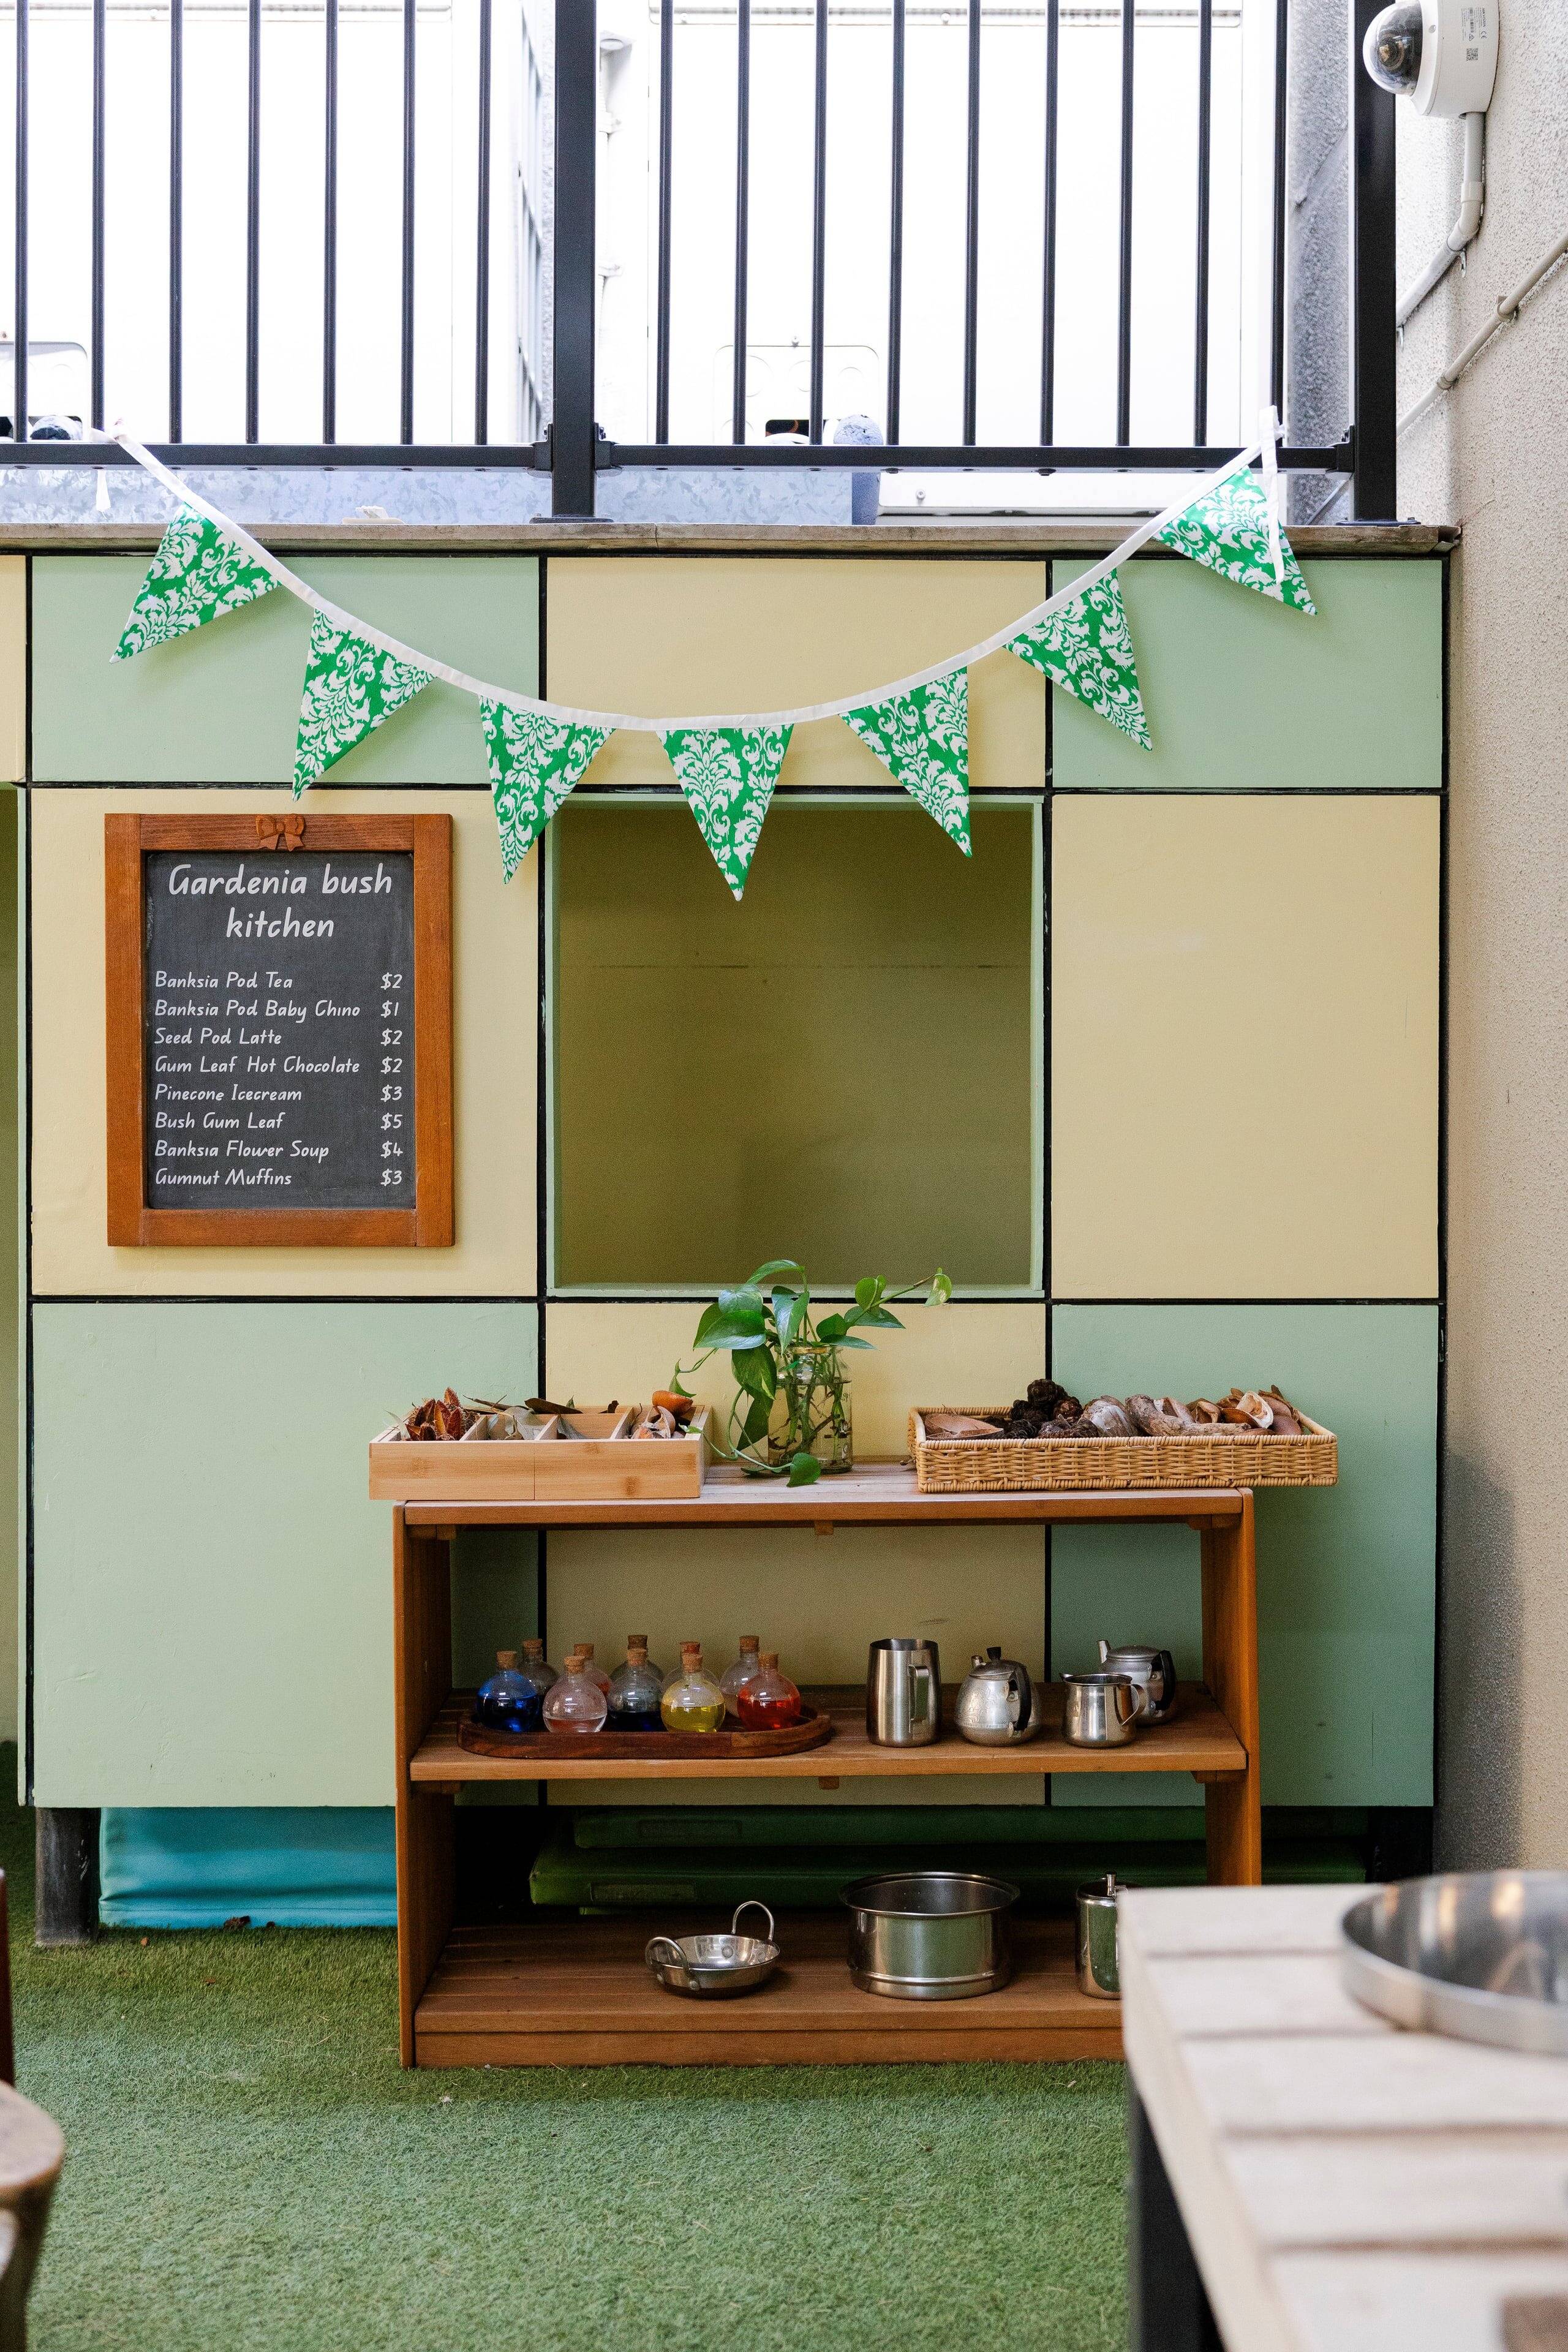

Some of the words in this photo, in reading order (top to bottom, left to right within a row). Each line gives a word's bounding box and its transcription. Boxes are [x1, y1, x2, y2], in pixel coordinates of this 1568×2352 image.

[169, 864, 307, 895] Gardenia
[322, 863, 391, 894] bush
[227, 907, 334, 937] kitchen
[156, 971, 218, 988] Banksia
[227, 972, 257, 988] Pod
[266, 971, 292, 988] Tea
[380, 972, 402, 990] $2
[155, 1000, 218, 1016] Banksia
[227, 1000, 257, 1016] Pod
[266, 1000, 306, 1023] Baby
[315, 1000, 360, 1016] Chino
[381, 1000, 399, 1018] $1
[154, 1028, 192, 1044] Seed
[200, 1028, 231, 1044] Pod
[239, 1028, 281, 1044] Latte
[380, 1028, 402, 1046] $2
[156, 1056, 191, 1072] Gum
[200, 1056, 238, 1072] Leaf
[247, 1056, 276, 1072] Hot
[284, 1056, 360, 1072] Chocolate
[380, 1057, 402, 1074] $2
[156, 1084, 224, 1101] Pinecone
[232, 1084, 301, 1101] Icecream
[380, 1085, 402, 1102] $3
[156, 1112, 195, 1128] Bush
[203, 1112, 239, 1128] Gum
[248, 1112, 285, 1128] Leaf
[380, 1112, 402, 1130] $5
[155, 1140, 218, 1156] Banksia
[227, 1140, 284, 1156] Flower
[290, 1140, 328, 1163] Soup
[380, 1140, 403, 1158] $4
[156, 1168, 220, 1185] Gumnut
[225, 1169, 292, 1185] Muffins
[380, 1169, 402, 1186] $3
